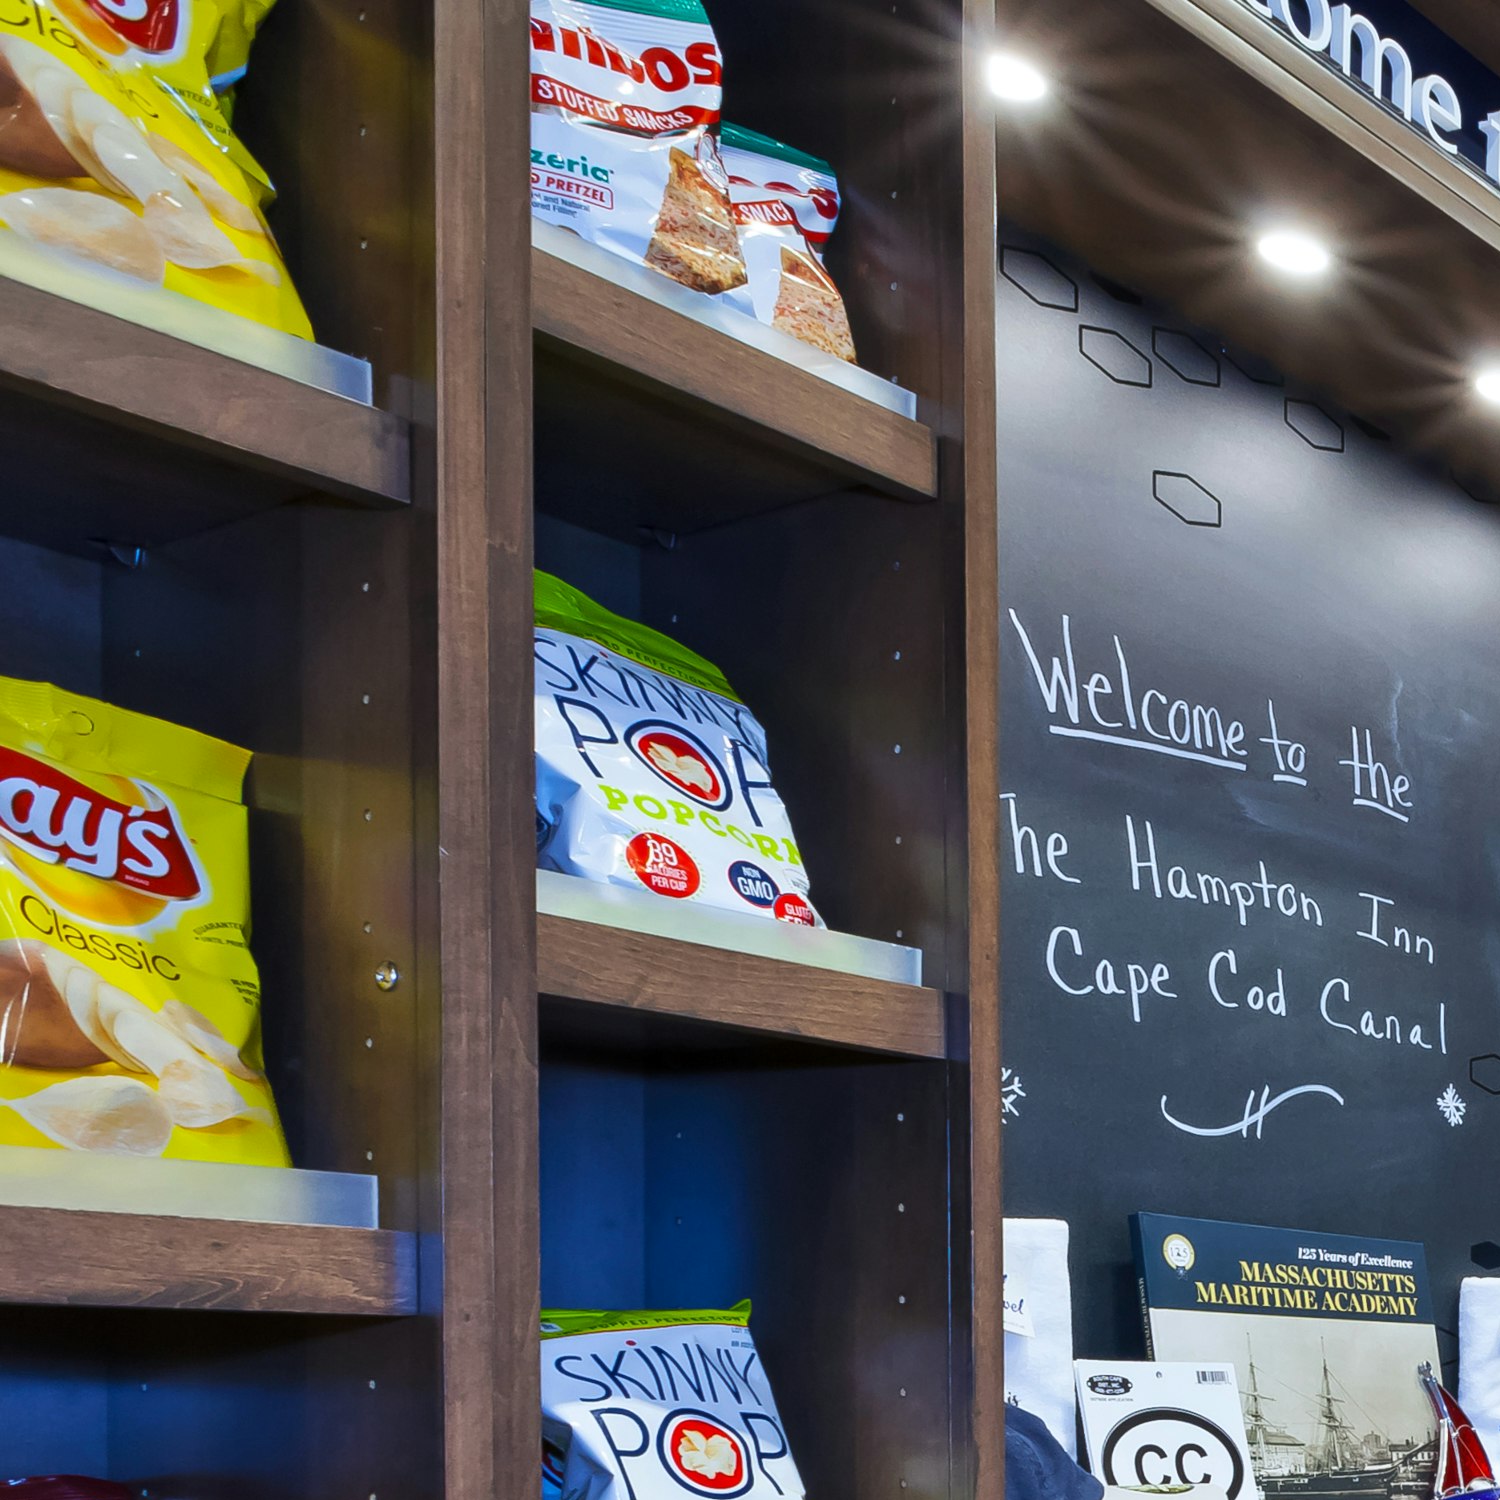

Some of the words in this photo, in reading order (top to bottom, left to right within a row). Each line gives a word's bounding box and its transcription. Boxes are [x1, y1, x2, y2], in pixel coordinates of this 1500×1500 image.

[537, 80, 620, 122] STUFFED
[624, 107, 694, 131] SNACKS
[546, 175, 607, 203] PRETZEL
[1008, 607, 1248, 757] Welcome
[1259, 698, 1306, 772] to
[1339, 725, 1414, 808] the
[554, 693, 772, 828] POP
[0, 776, 171, 880] ay's
[651, 875, 670, 890] PER
[670, 877, 689, 892] CUP
[737, 875, 773, 900] GMO
[1126, 814, 1323, 926] Hampton
[1357, 892, 1435, 964] Inn
[20, 895, 181, 981] Classic
[1046, 925, 1178, 1022] Cape
[1208, 949, 1287, 1017] Cod
[1320, 978, 1447, 1055] Canal
[1239, 1260, 1416, 1294] MASSACHUSETTS
[1297, 1246, 1316, 1262] 125
[1317, 1248, 1348, 1264] Years
[1348, 1250, 1362, 1267] of
[1360, 1252, 1414, 1270] Excellence
[1194, 1280, 1318, 1311] MARITIME
[1321, 1289, 1419, 1317] ACADEMY
[590, 1407, 788, 1500] POP
[1134, 1442, 1212, 1485] CC
